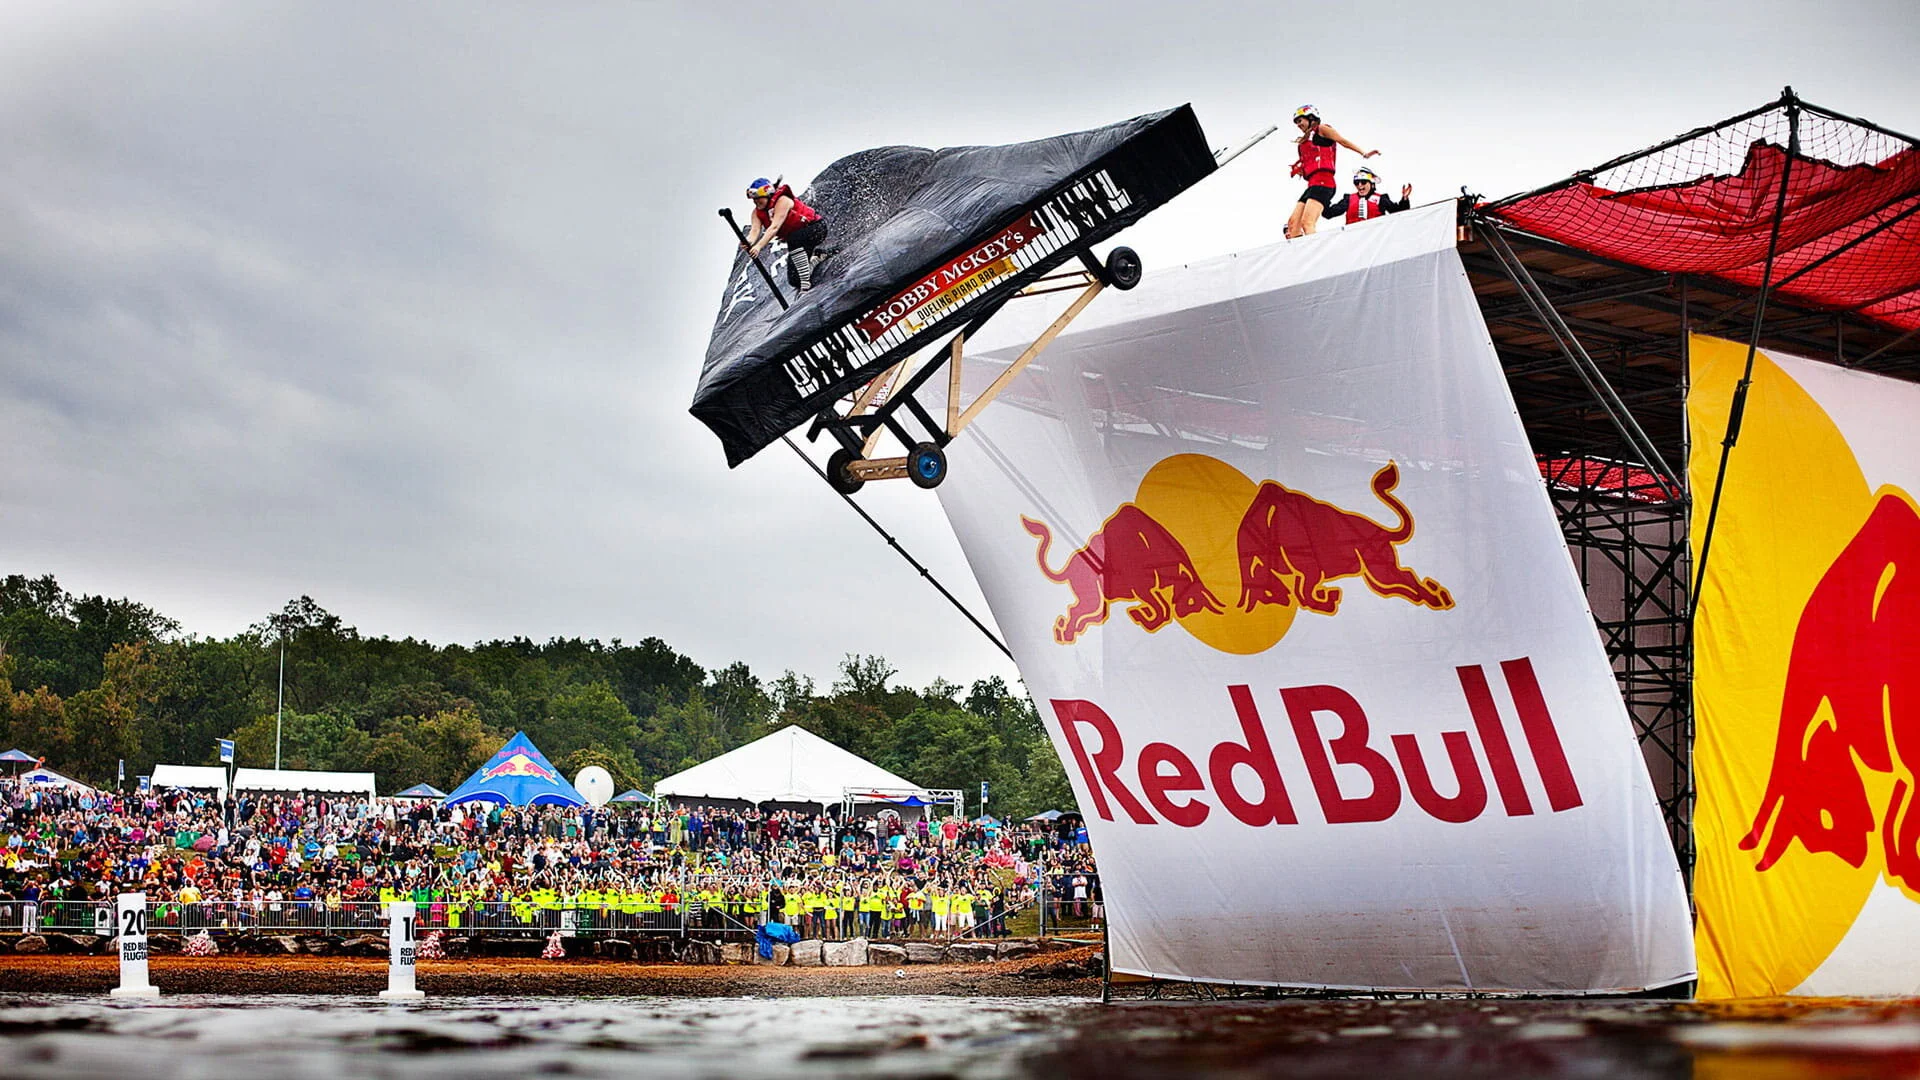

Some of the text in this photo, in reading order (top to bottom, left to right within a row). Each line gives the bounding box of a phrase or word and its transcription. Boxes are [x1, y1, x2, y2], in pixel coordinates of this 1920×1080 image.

[874, 275, 942, 328] BOBBY
[916, 267, 997, 321] DUELING PIANO BAR
[1049, 656, 1584, 828] Red Bull
[122, 909, 146, 936] 20
[123, 942, 137, 952] RED
[400, 947, 412, 956] RED
